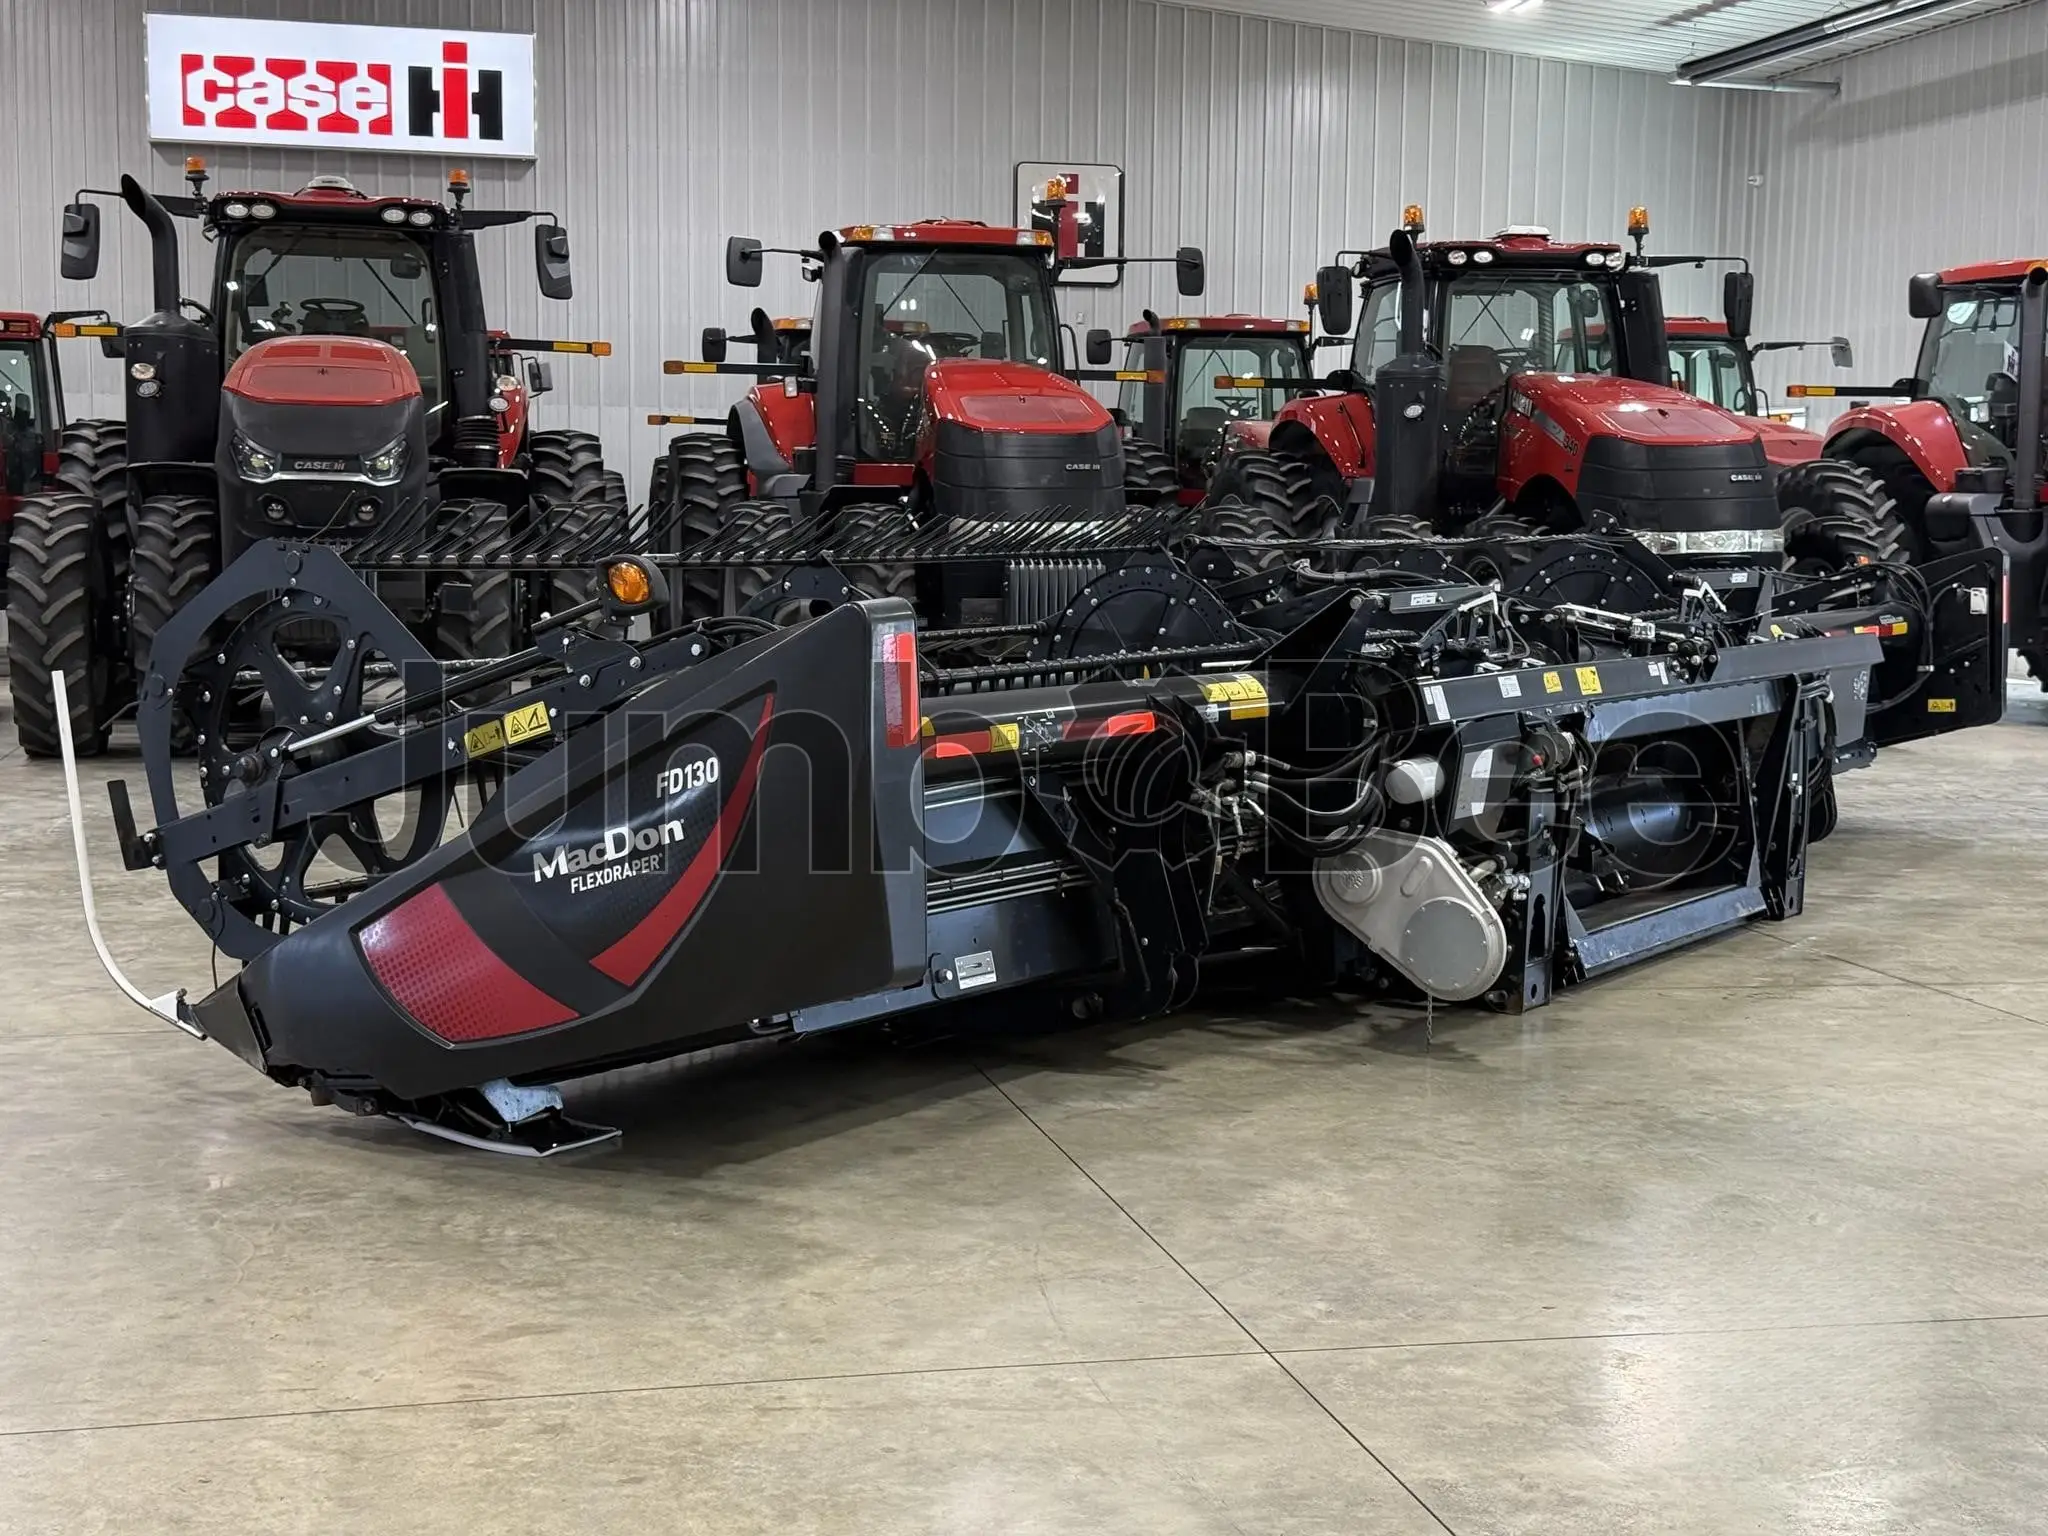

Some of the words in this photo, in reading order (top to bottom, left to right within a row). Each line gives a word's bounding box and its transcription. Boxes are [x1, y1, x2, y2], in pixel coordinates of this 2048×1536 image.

[294, 460, 331, 470] CASE
[656, 756, 720, 799] FD130
[532, 818, 686, 883] MacDon
[570, 853, 664, 894] FLEXDRAPER
